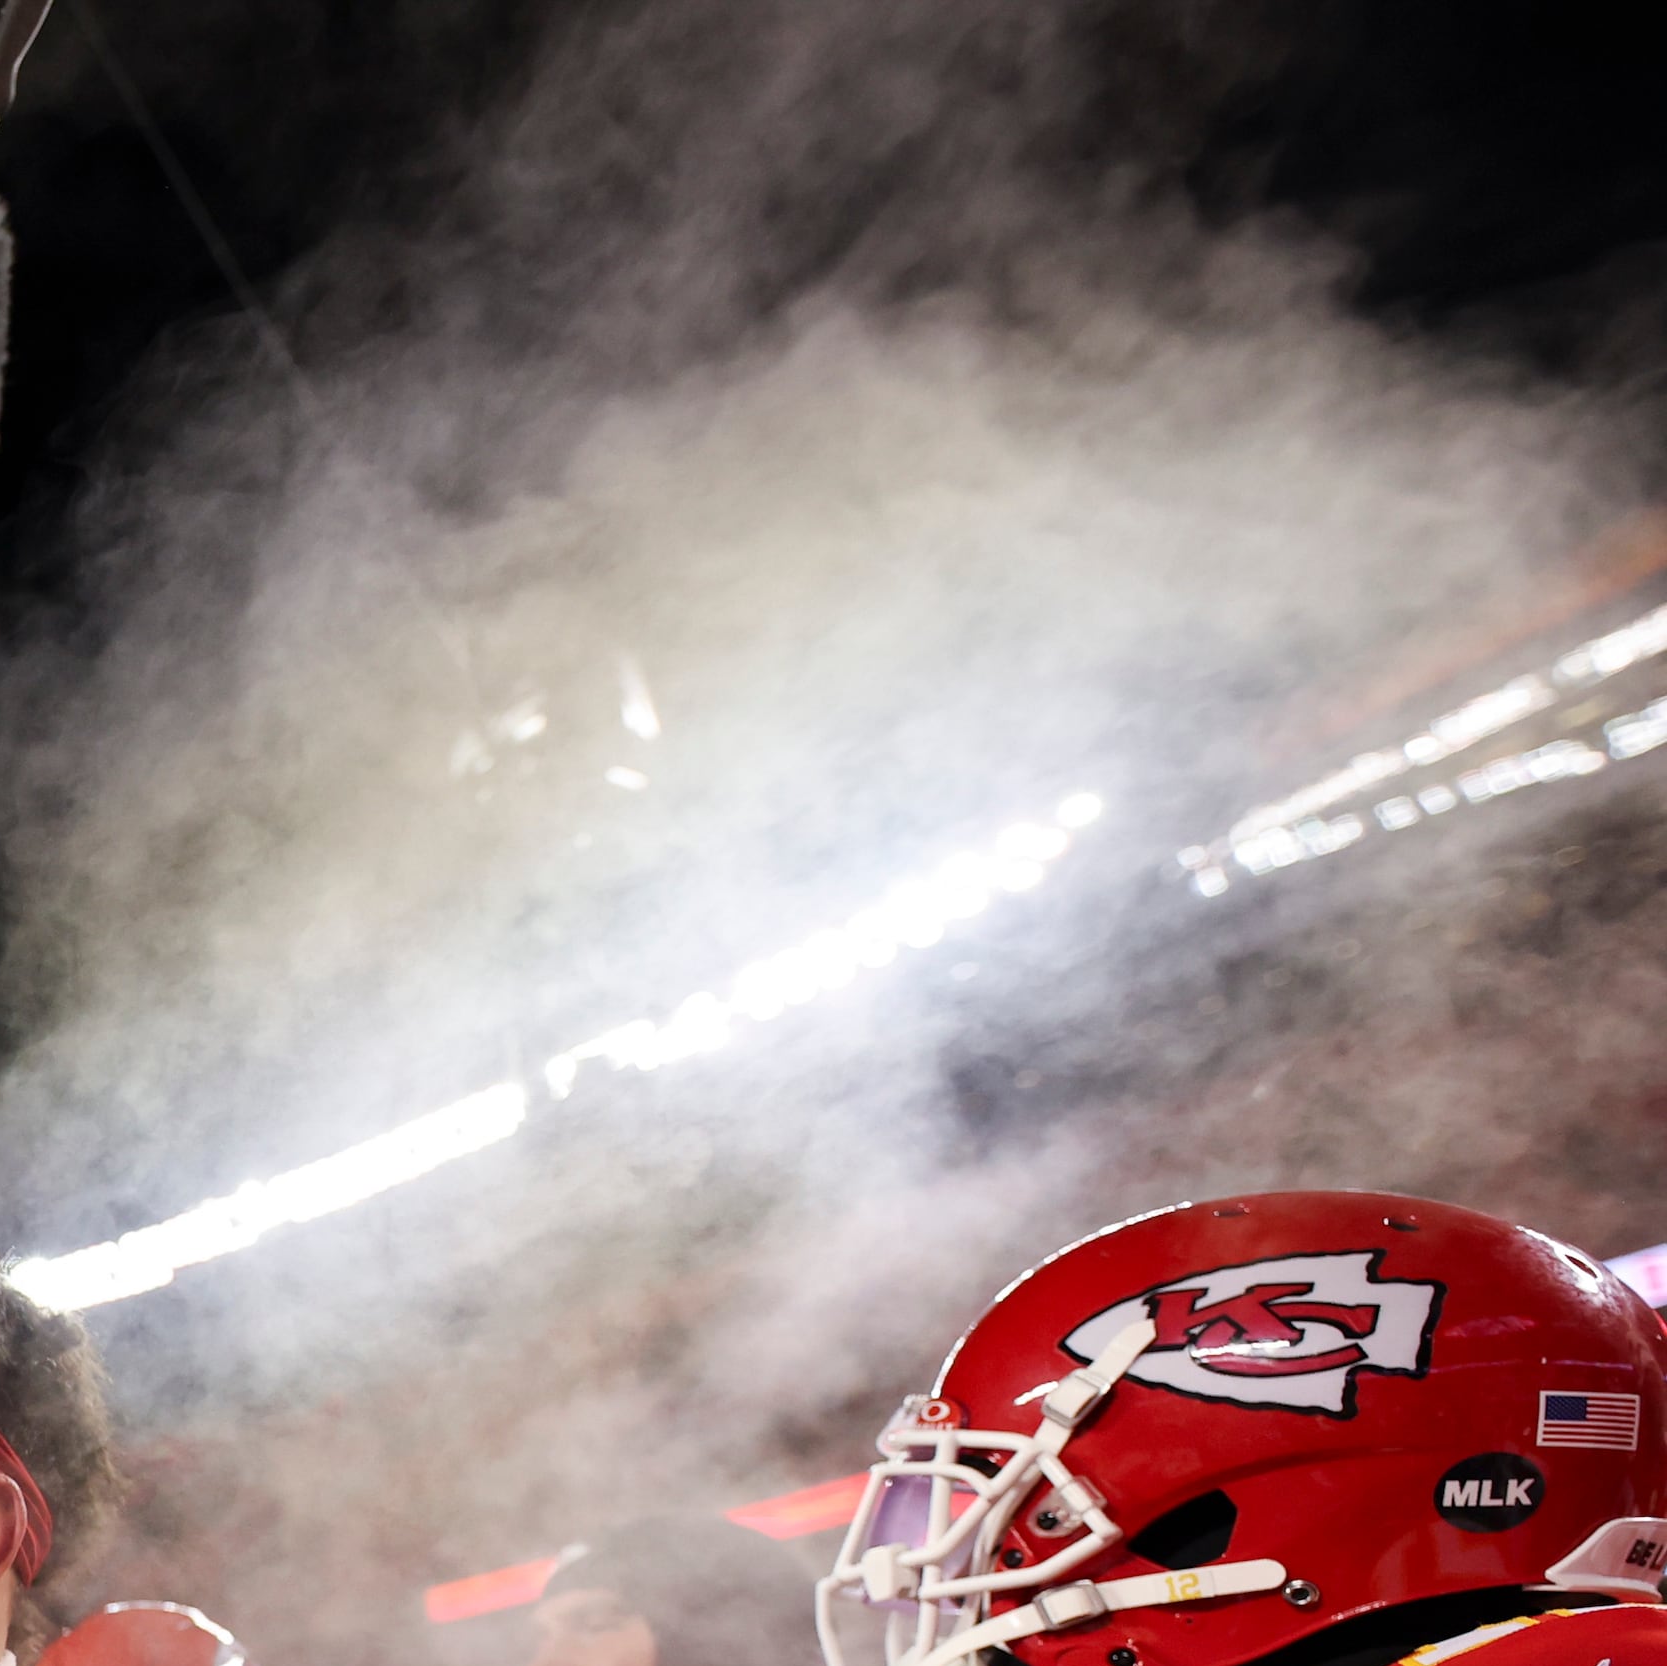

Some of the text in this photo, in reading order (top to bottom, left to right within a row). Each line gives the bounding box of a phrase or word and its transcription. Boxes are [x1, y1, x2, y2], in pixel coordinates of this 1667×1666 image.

[1143, 1282, 1381, 1377] KC
[1442, 1478, 1535, 1508] MLK
[1164, 1572, 1201, 1601] 12
